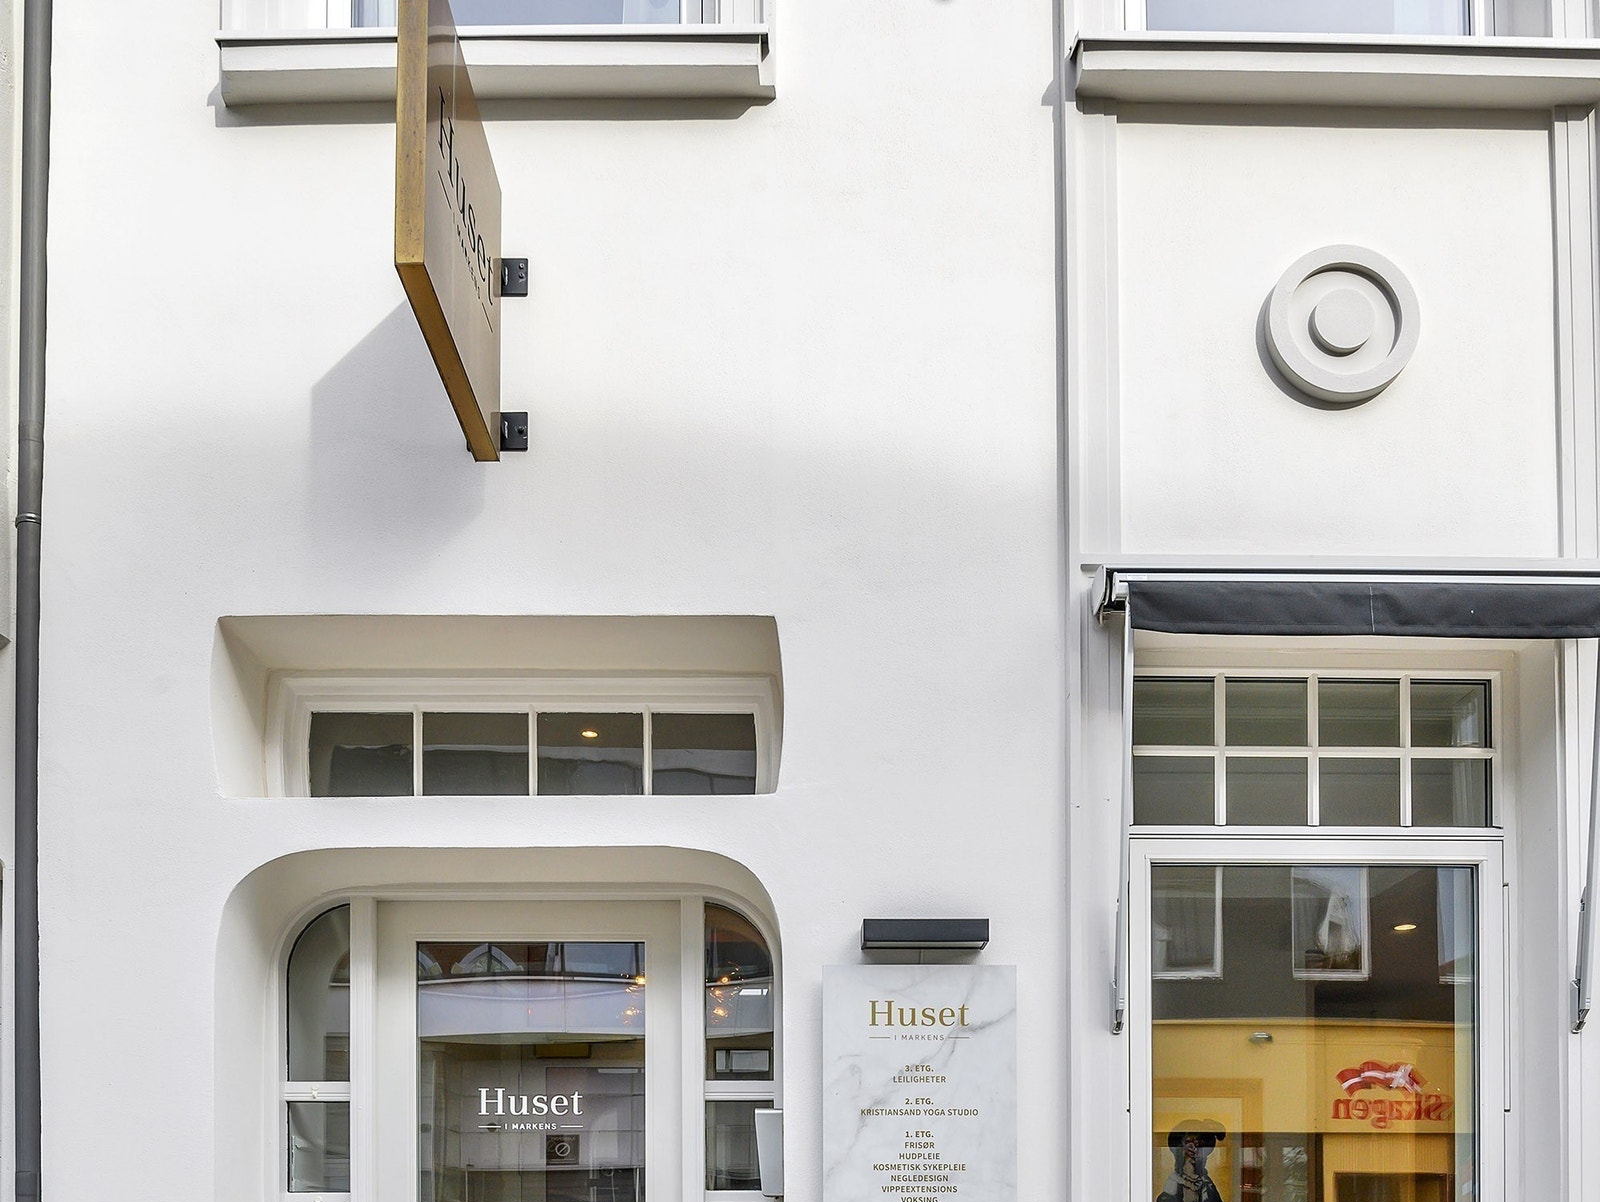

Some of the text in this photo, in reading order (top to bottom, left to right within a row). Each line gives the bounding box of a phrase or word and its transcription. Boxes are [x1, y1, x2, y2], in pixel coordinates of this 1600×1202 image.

[437, 86, 493, 306] Huset
[869, 1000, 970, 1027] Huset
[478, 1088, 583, 1115] Huset
